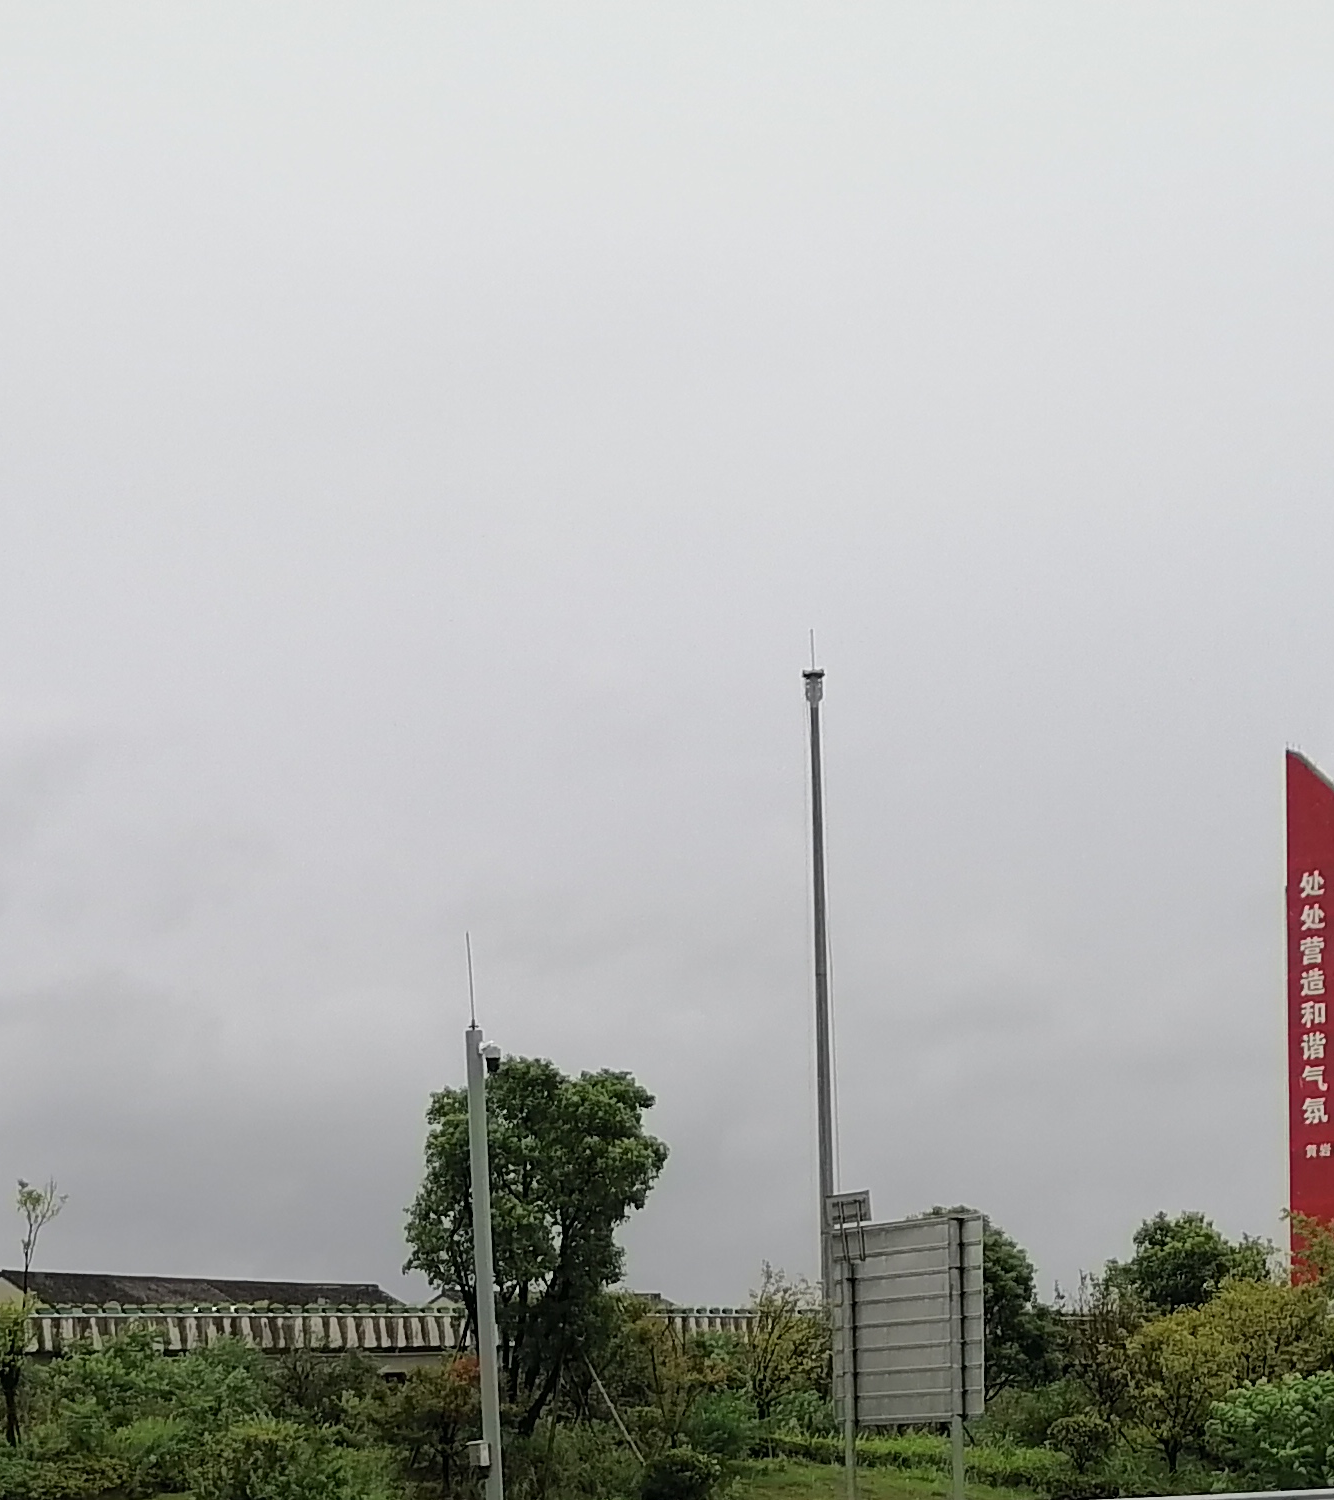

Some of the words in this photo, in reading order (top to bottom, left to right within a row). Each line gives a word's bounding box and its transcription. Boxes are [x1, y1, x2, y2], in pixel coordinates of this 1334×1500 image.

[1300, 869, 1328, 1124] 处处营造和谐气氛
